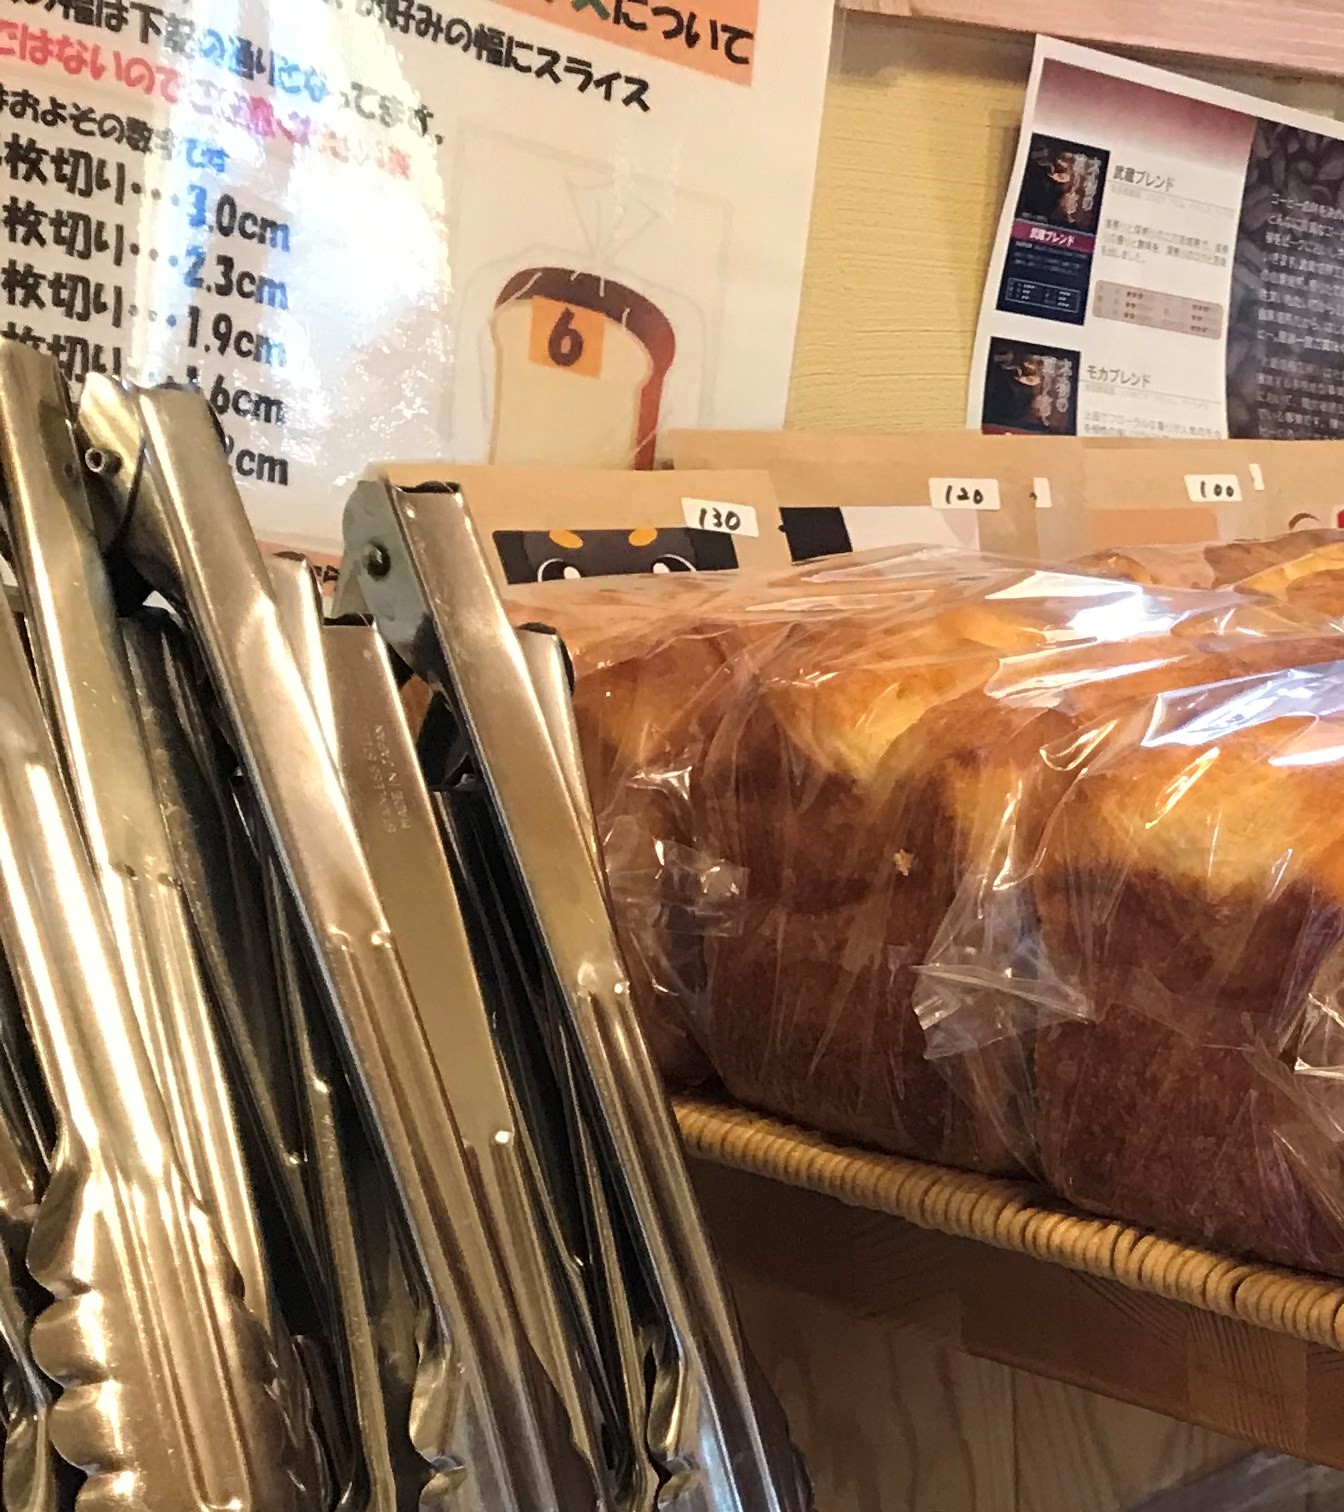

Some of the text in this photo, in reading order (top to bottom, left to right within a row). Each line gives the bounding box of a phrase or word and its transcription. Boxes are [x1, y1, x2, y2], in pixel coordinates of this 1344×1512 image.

[0, 82, 229, 173] およその数字です
[547, 307, 584, 366] 6
[1086, 365, 1151, 389] モカブレンド
[943, 484, 985, 506] 120
[1200, 479, 1235, 498] 100
[699, 507, 741, 531] 130
